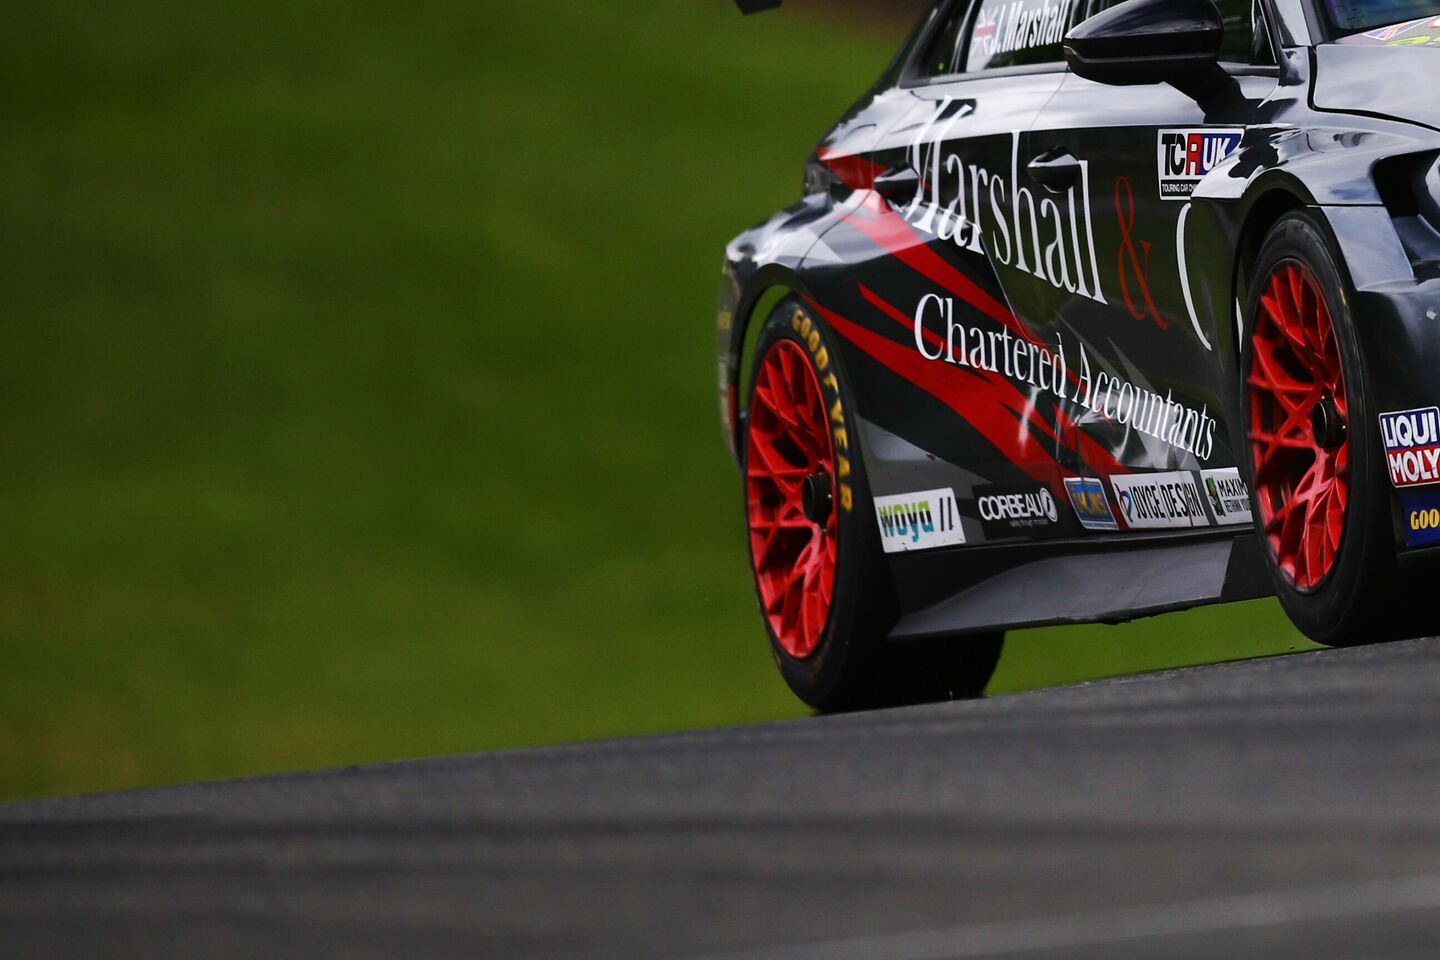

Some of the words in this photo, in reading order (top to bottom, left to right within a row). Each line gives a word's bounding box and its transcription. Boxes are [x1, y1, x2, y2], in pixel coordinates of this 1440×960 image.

[904, 93, 1109, 305] Marshall
[1114, 175, 1169, 331] &
[913, 292, 1067, 399] Chartered
[1071, 341, 1217, 461] Accountants
[1381, 411, 1439, 449] LIQUI
[978, 492, 1045, 521] CORBEAU
[1128, 485, 1167, 520] JOYCE
